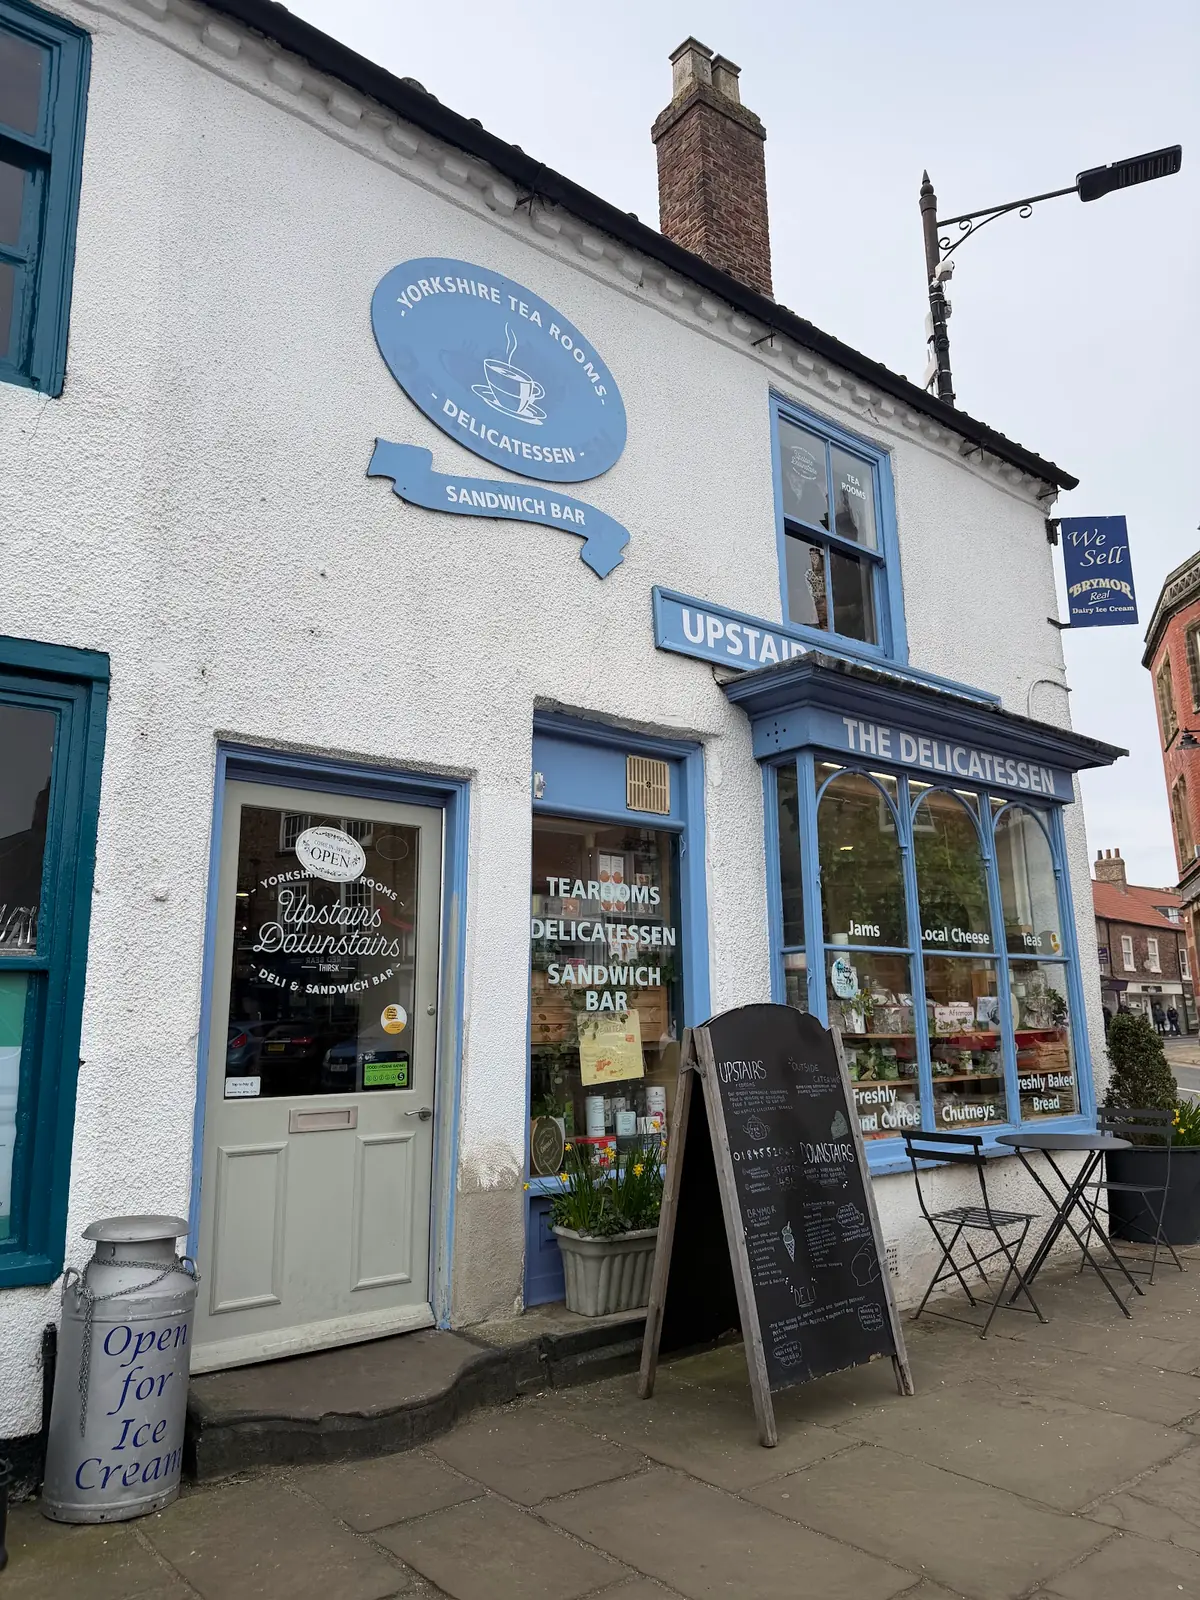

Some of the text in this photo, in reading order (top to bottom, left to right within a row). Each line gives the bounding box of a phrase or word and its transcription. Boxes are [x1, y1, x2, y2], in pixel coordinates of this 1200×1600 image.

[508, 295, 543, 328] TEA
[442, 398, 576, 464] DELICATESSEN
[841, 473, 866, 500] TEA ROOMS
[445, 485, 586, 525] SANDWICH BAR
[1067, 528, 1106, 547] We
[1080, 546, 1127, 567] Sell
[1069, 578, 1134, 600] BRYMOR
[1090, 590, 1110, 601] Real
[1072, 607, 1094, 615] Dairy
[842, 717, 1055, 794] THE DELICATESSEN
[310, 846, 349, 868] OPEN
[359, 875, 398, 901] ROOMS
[546, 876, 661, 906] TEAROOMS
[278, 889, 382, 932] Upstairs
[252, 921, 401, 957] Downstairs
[531, 918, 676, 946] DELICATESSEN
[848, 920, 880, 938] Jams
[951, 928, 990, 944] Cheese
[1021, 932, 1042, 947] Teas
[319, 964, 340, 972] THIRSK
[547, 963, 661, 986] SANDWICH
[258, 968, 394, 995] DELI & SANDWICH BAR
[585, 990, 628, 1011] BAR
[718, 1060, 767, 1083] UPSTAIRS
[1017, 1071, 1074, 1092] reshly Baked
[852, 1085, 897, 1107] Freshly
[1033, 1094, 1060, 1111] Bread
[881, 1108, 920, 1129] Coffee
[941, 1104, 995, 1123] Chutneys
[794, 1286, 816, 1305] DELI
[103, 1324, 188, 1367] Open
[107, 1366, 173, 1415] for
[111, 1418, 168, 1450] Ice
[75, 1446, 182, 1490] Cream
